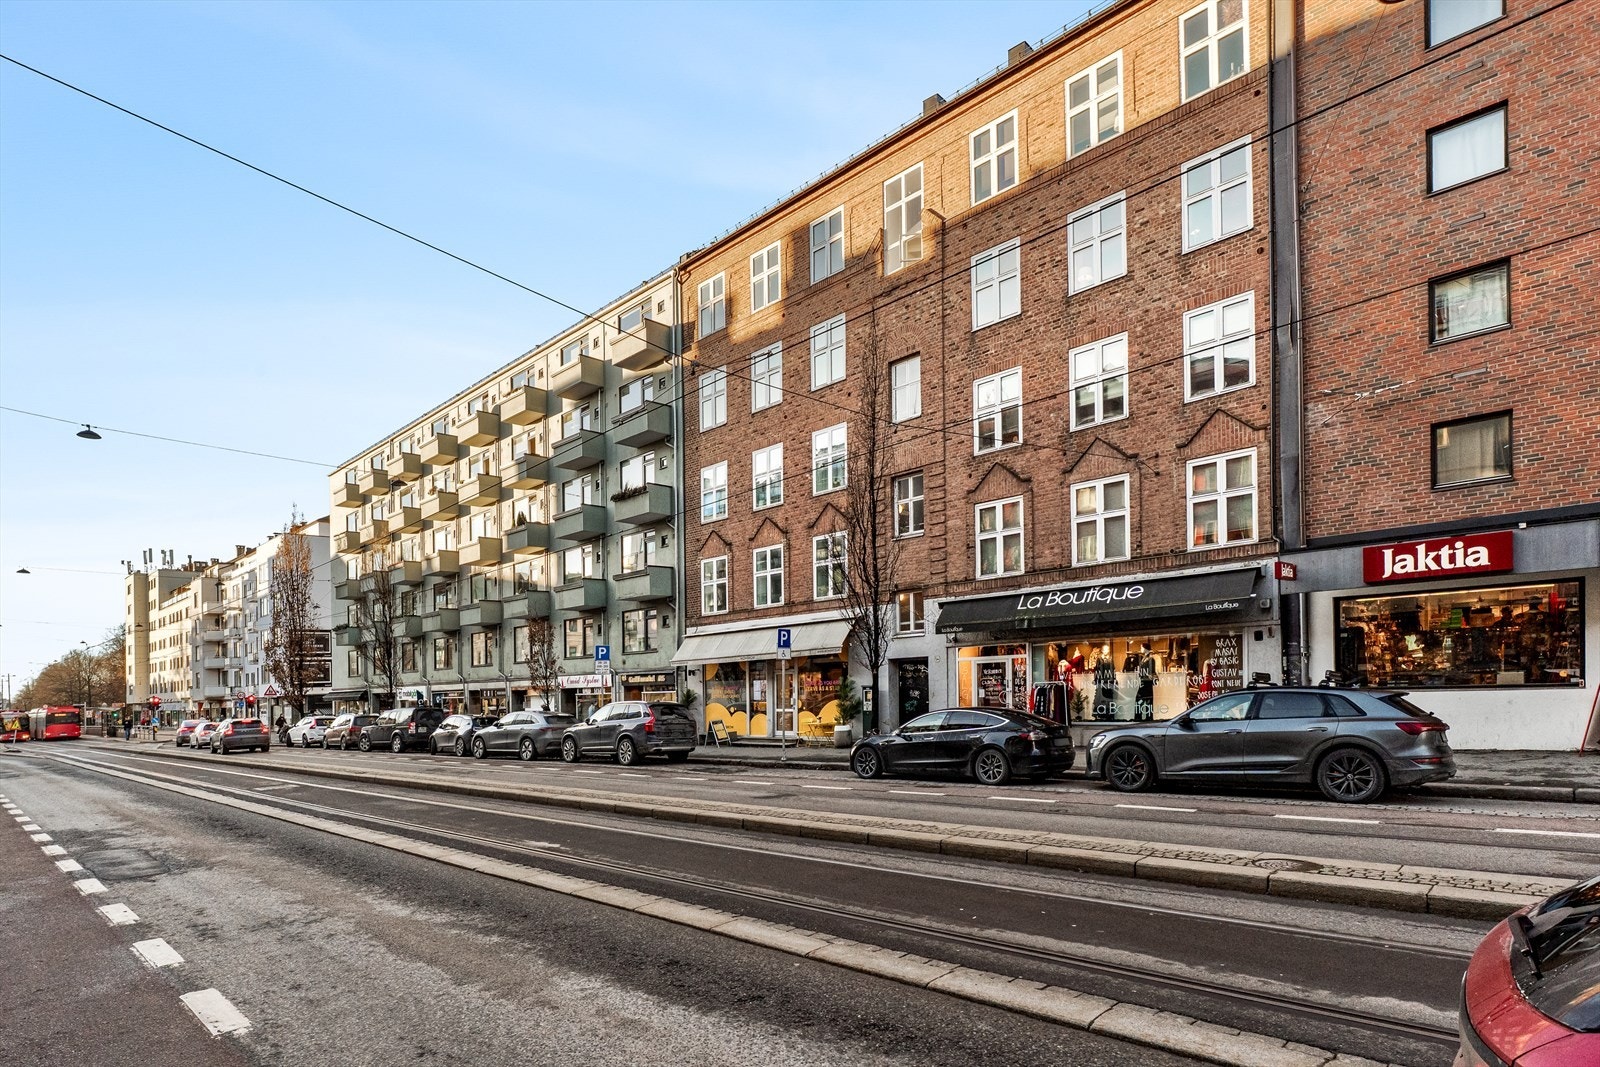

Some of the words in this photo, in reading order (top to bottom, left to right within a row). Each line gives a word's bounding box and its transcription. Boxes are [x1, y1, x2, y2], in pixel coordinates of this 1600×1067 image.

[1381, 541, 1491, 579] Jaktia
[1017, 594, 1043, 610] La
[1045, 585, 1144, 607] Boutique
[1213, 602, 1239, 610] Boutique
[780, 631, 788, 646] P
[1215, 638, 1237, 648] BRAX
[598, 647, 607, 659] P
[1214, 647, 1238, 657] MASAI
[1219, 656, 1239, 665] BASIC
[1211, 668, 1237, 678] GUSTAV
